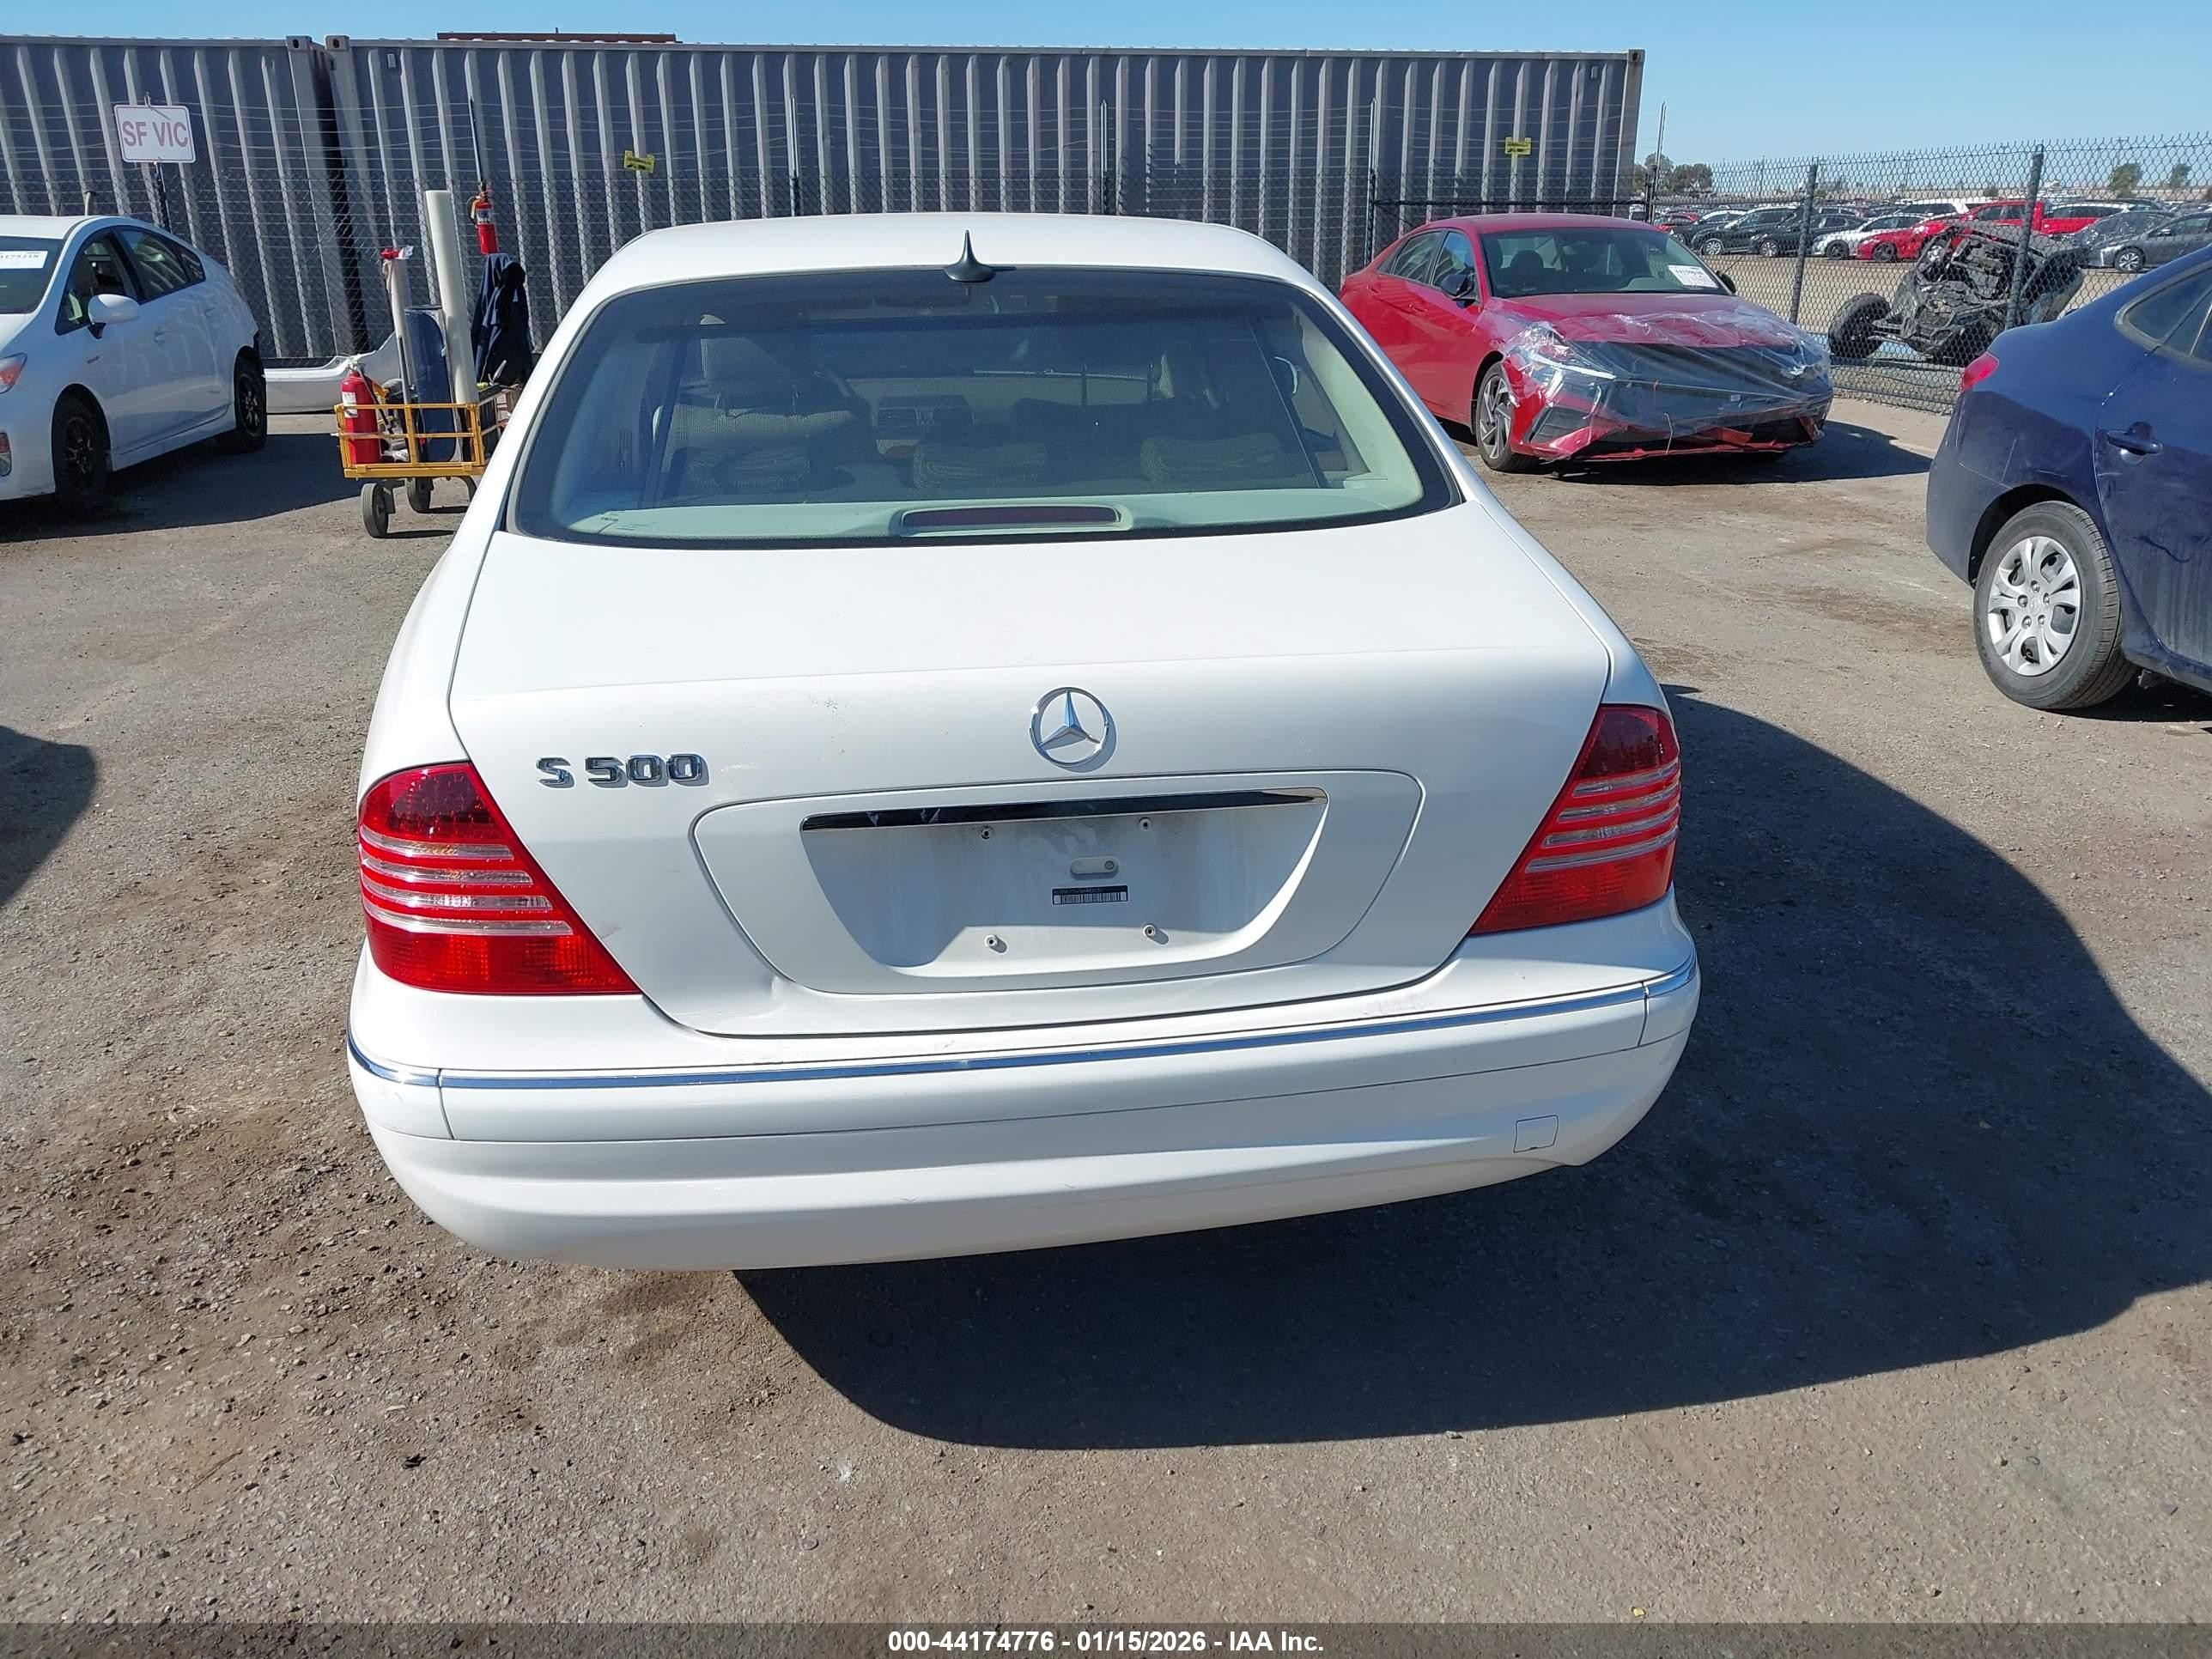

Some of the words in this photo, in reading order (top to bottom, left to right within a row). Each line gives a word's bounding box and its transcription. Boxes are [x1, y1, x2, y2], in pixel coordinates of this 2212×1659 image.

[122, 121, 147, 147] SF
[152, 121, 188, 147] VIC
[536, 757, 573, 787] S
[585, 753, 708, 787] 500
